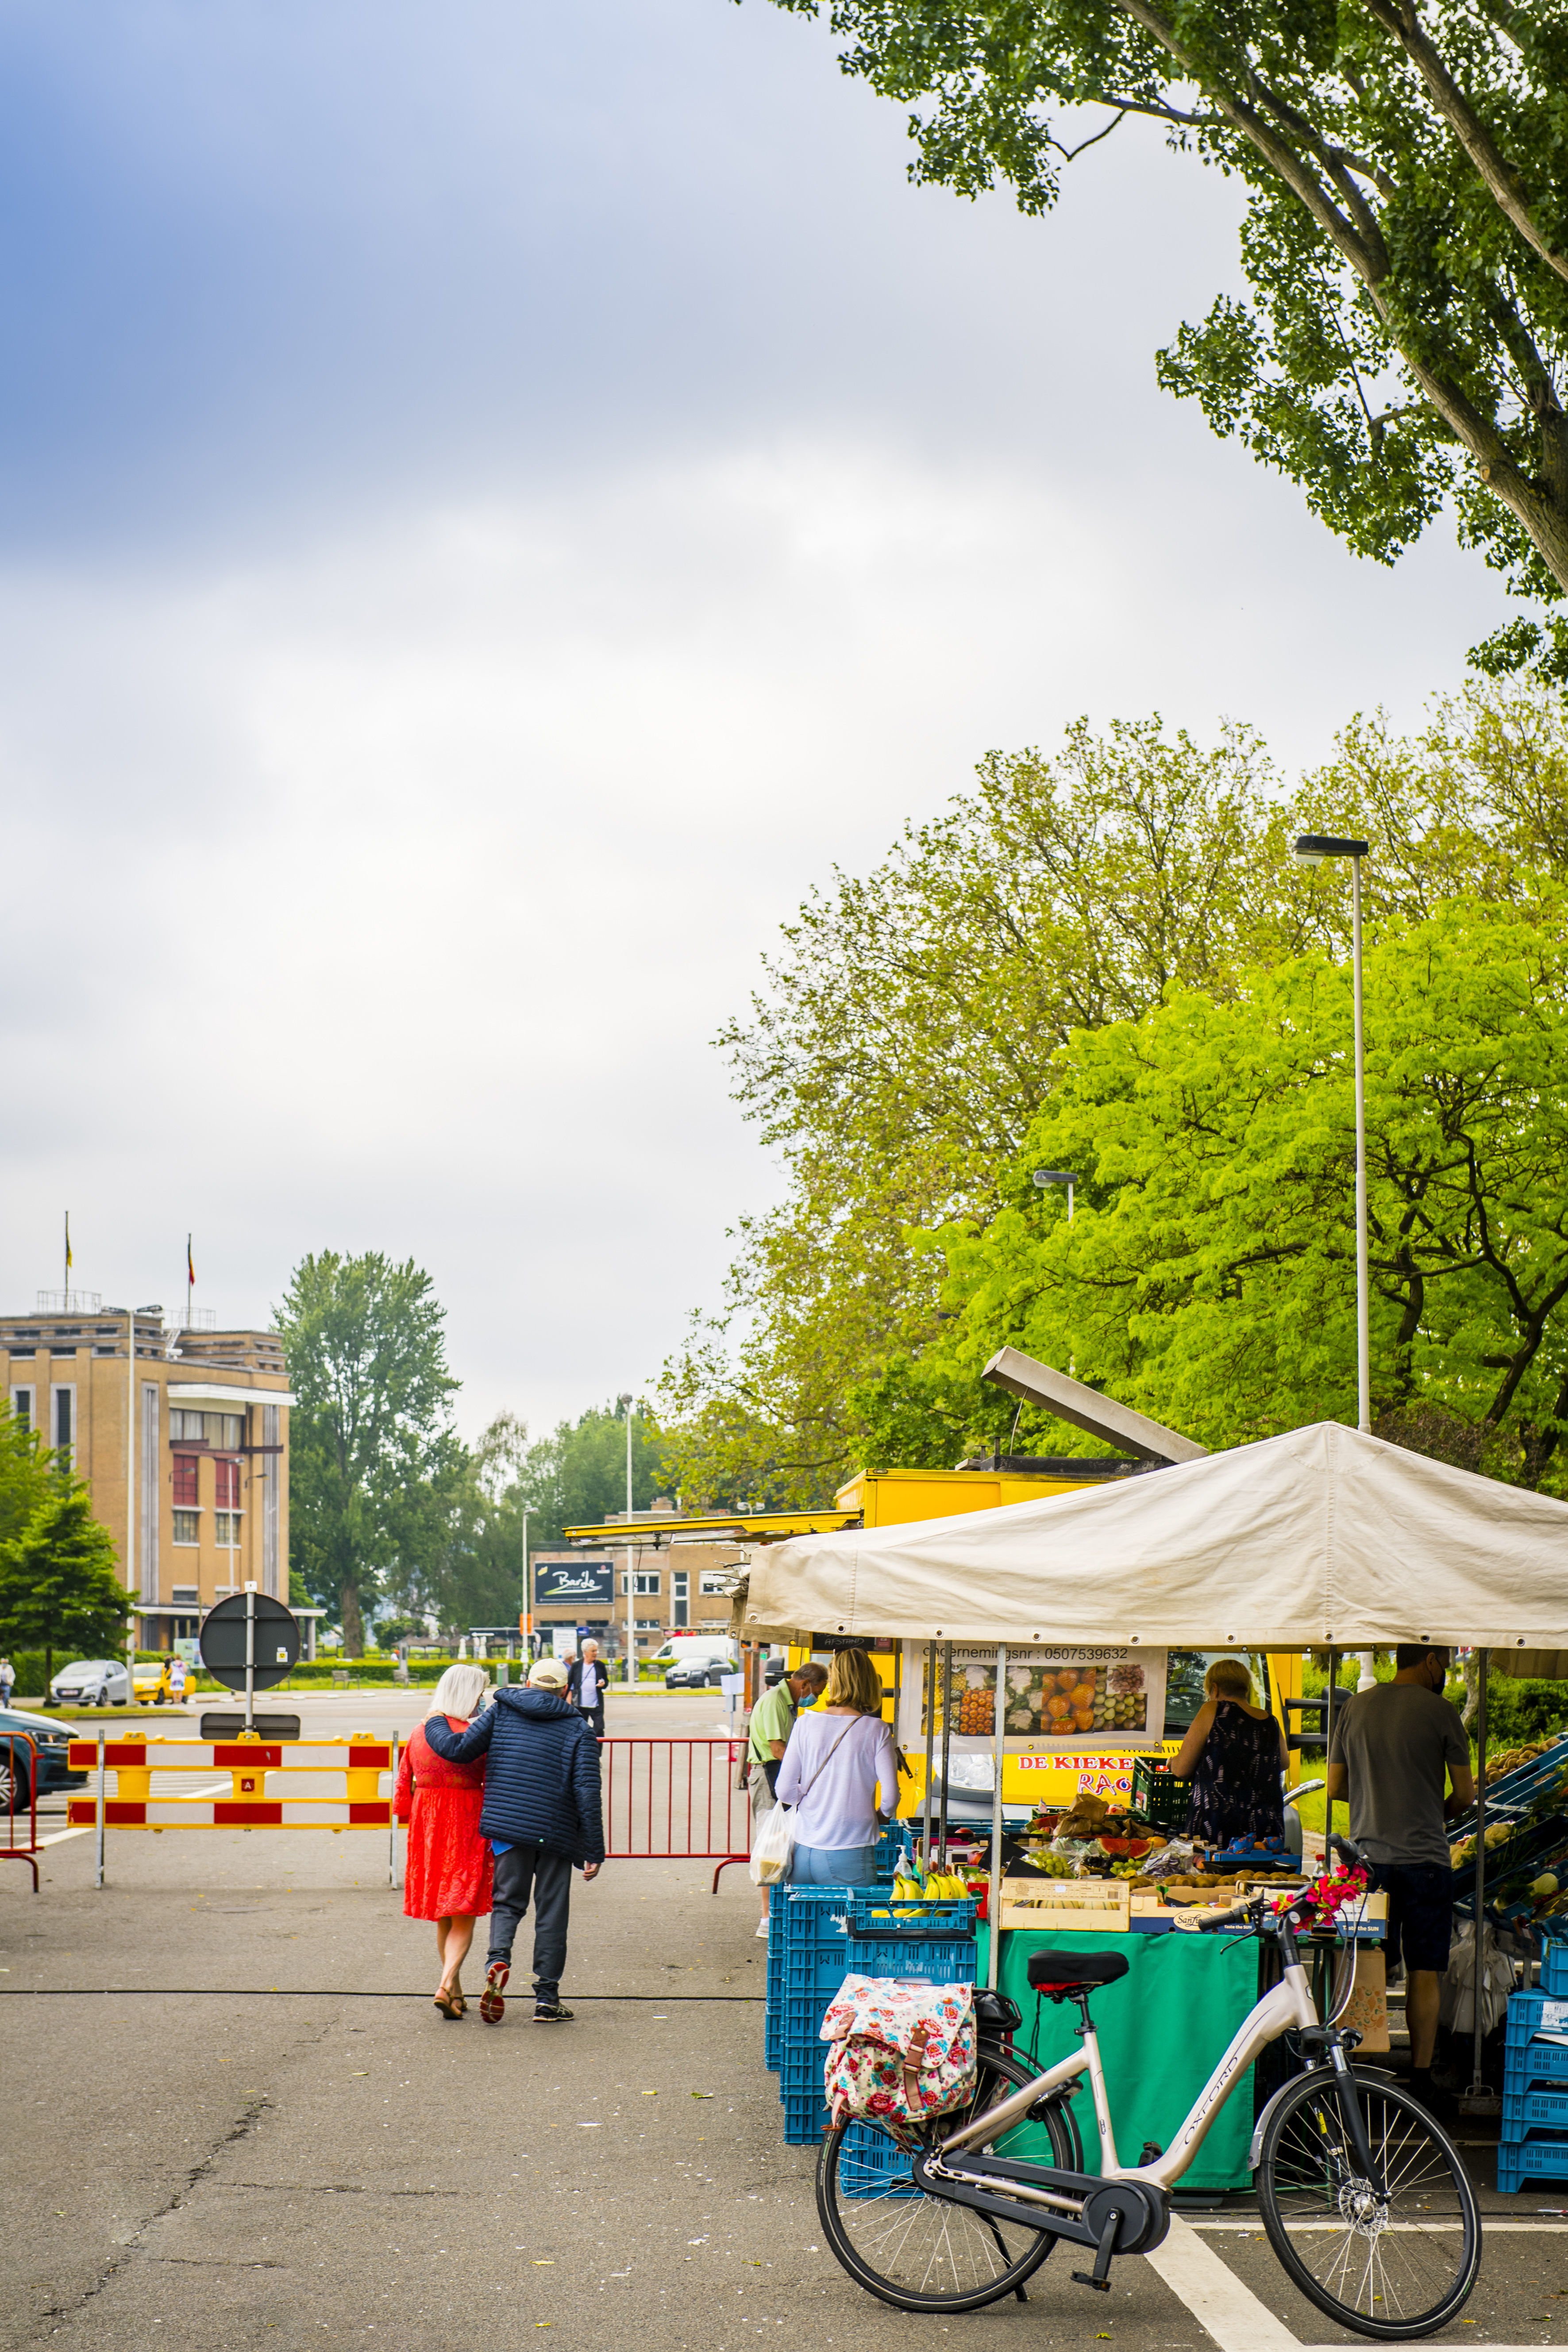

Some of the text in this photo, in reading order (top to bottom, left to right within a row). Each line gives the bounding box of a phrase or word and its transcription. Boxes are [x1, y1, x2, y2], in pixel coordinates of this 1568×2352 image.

[824, 1637, 865, 1648] AFSTAND
[923, 1647, 1032, 1662] onernemigsnr
[1045, 1648, 1128, 1660] 0507539632
[1018, 1756, 1135, 1770] DE KIEKE
[244, 1781, 252, 1790] A
[1077, 1773, 1132, 1795] RAO
[1184, 2056, 1239, 2145] OXFORD
